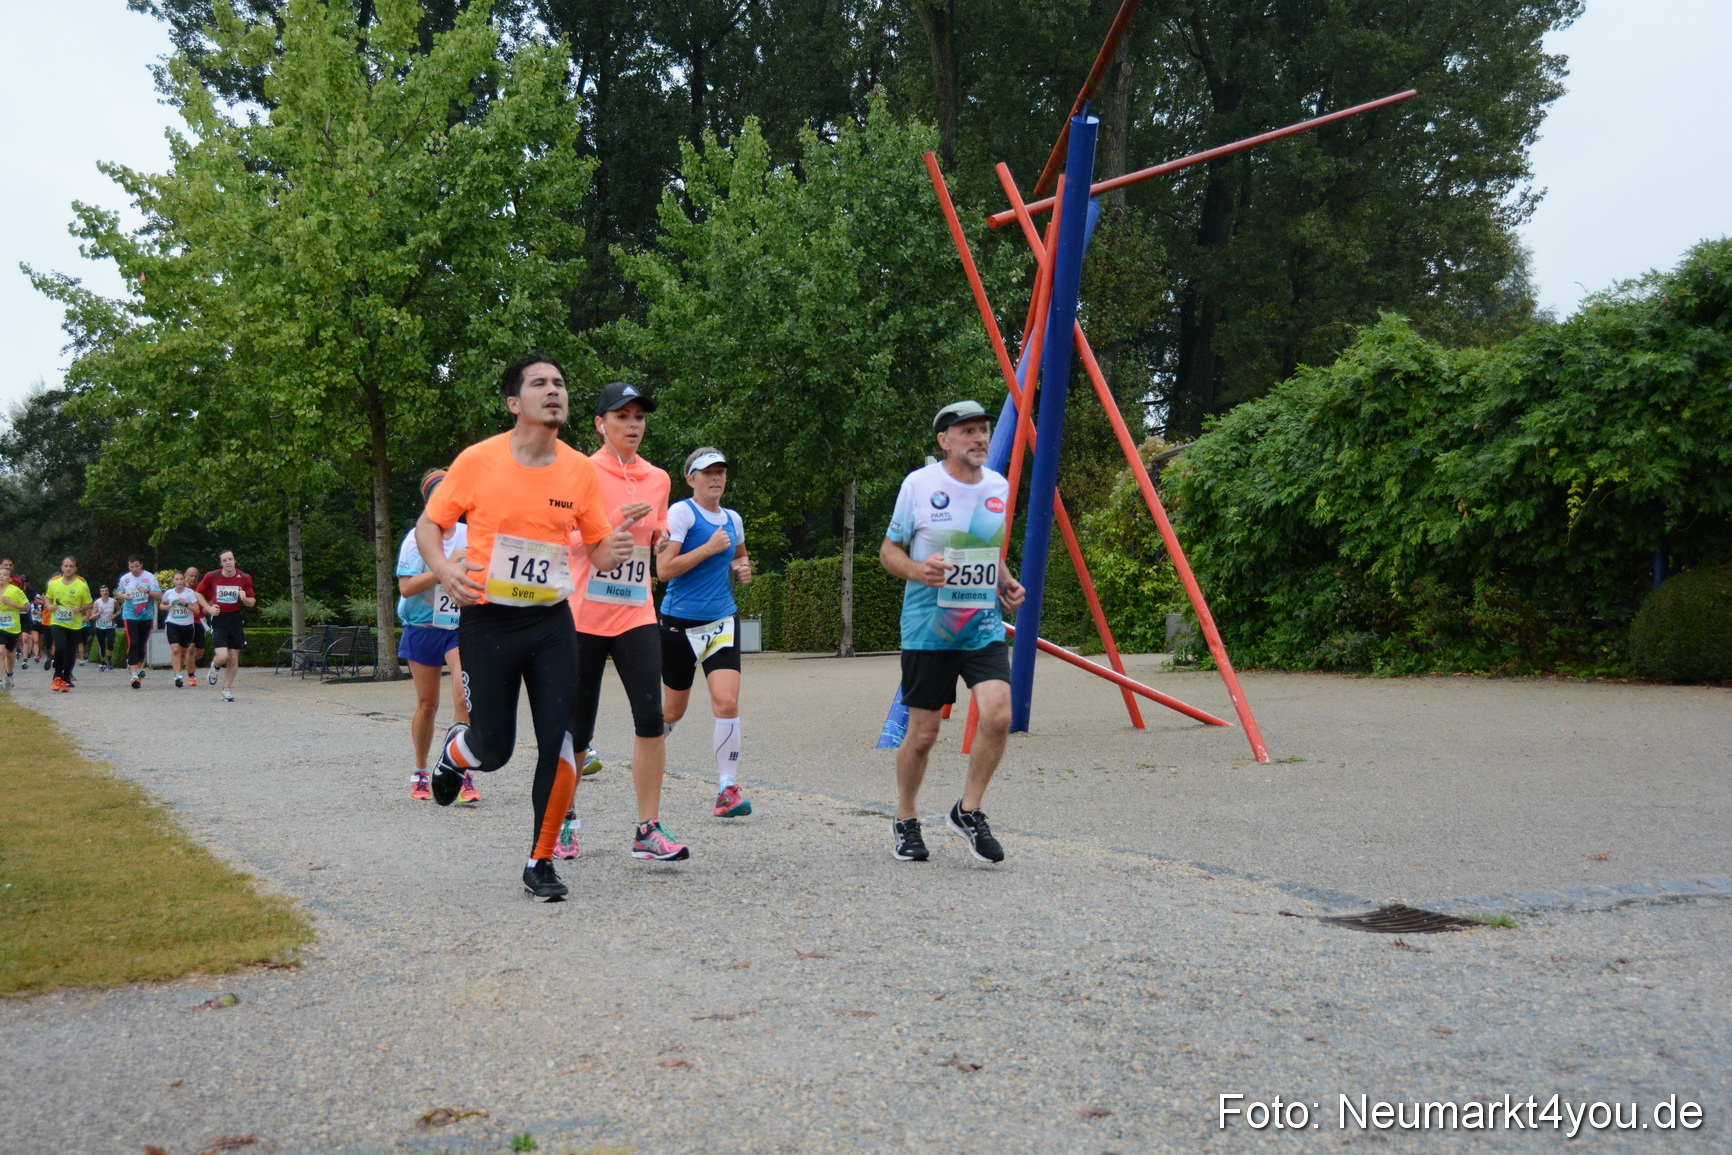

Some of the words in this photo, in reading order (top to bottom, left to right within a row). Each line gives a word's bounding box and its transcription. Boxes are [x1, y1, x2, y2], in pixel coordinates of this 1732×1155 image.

[548, 498, 574, 509] THULE
[508, 554, 550, 584] 143
[946, 563, 996, 586] 2530
[218, 590, 237, 598] 3046
[512, 586, 535, 599] Sven
[606, 585, 632, 597] Nicola
[951, 590, 988, 600] Klemens
